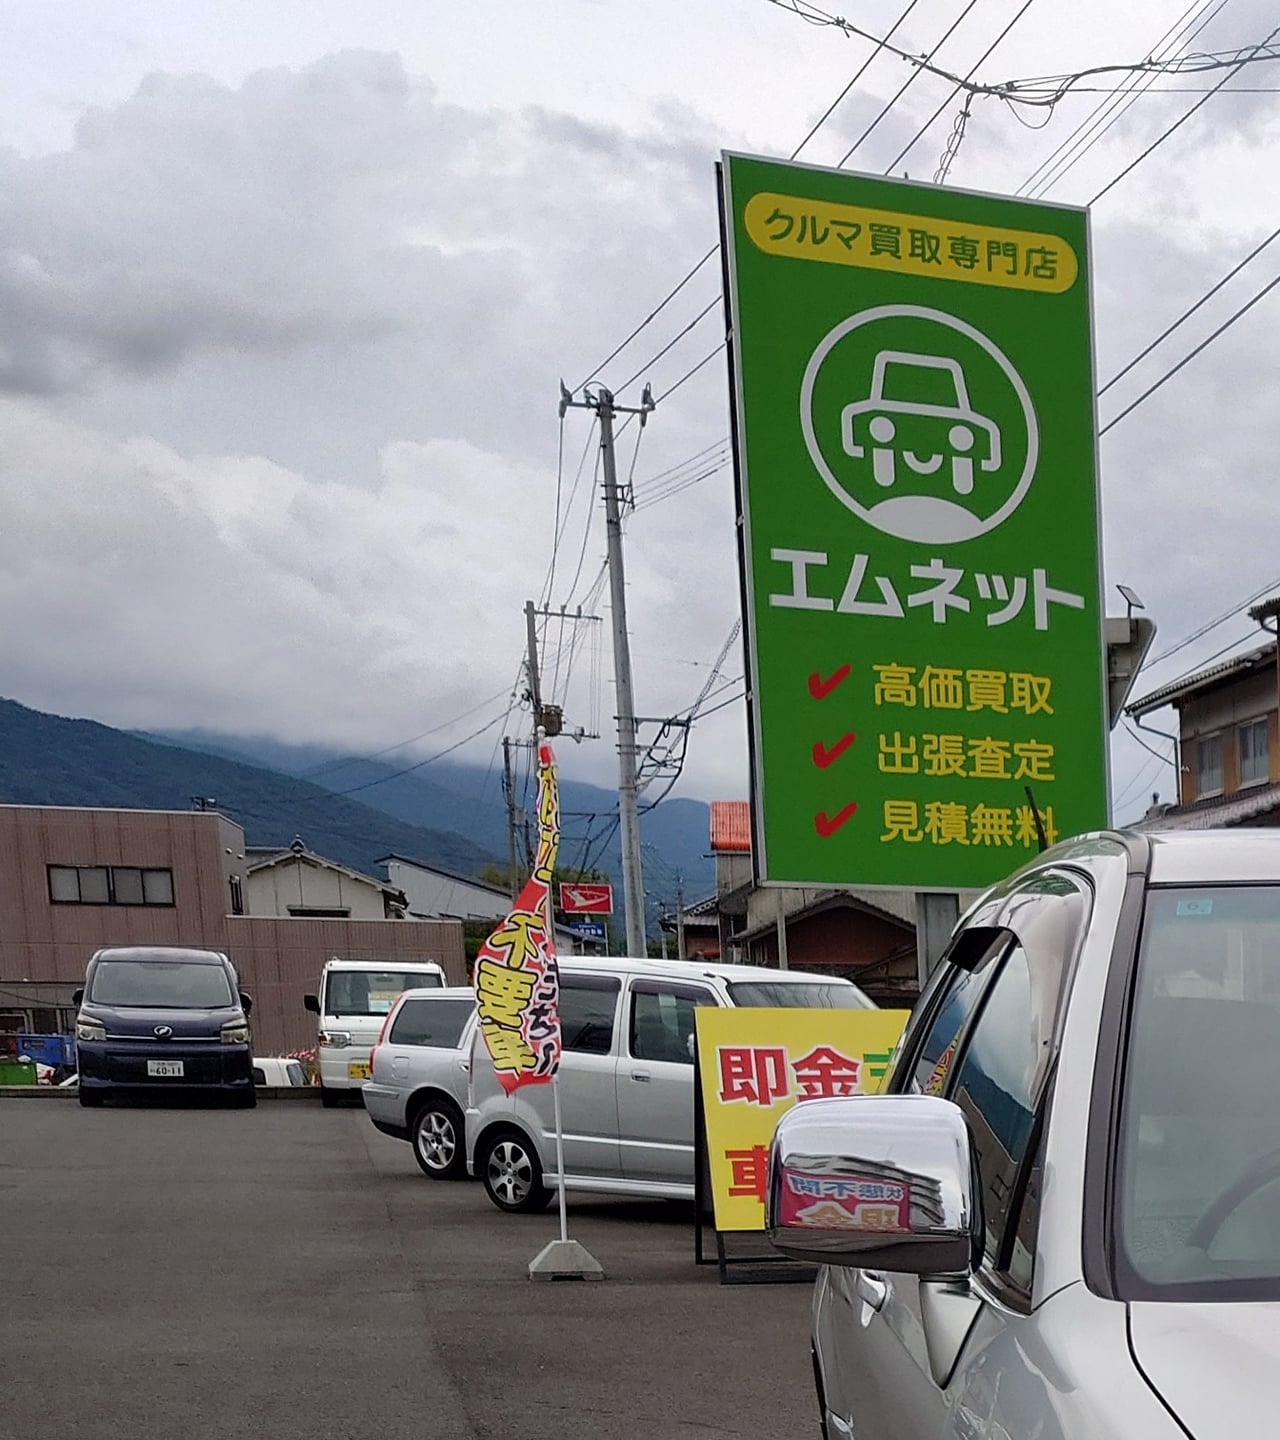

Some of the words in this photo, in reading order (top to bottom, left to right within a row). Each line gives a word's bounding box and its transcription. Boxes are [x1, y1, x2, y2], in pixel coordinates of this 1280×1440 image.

[763, 206, 1059, 281] クルマ買取専門店
[768, 547, 1085, 631] エムネット
[872, 662, 1055, 715] 高価買取
[877, 732, 1056, 781] 出張査定
[879, 800, 1059, 848] 見積無料
